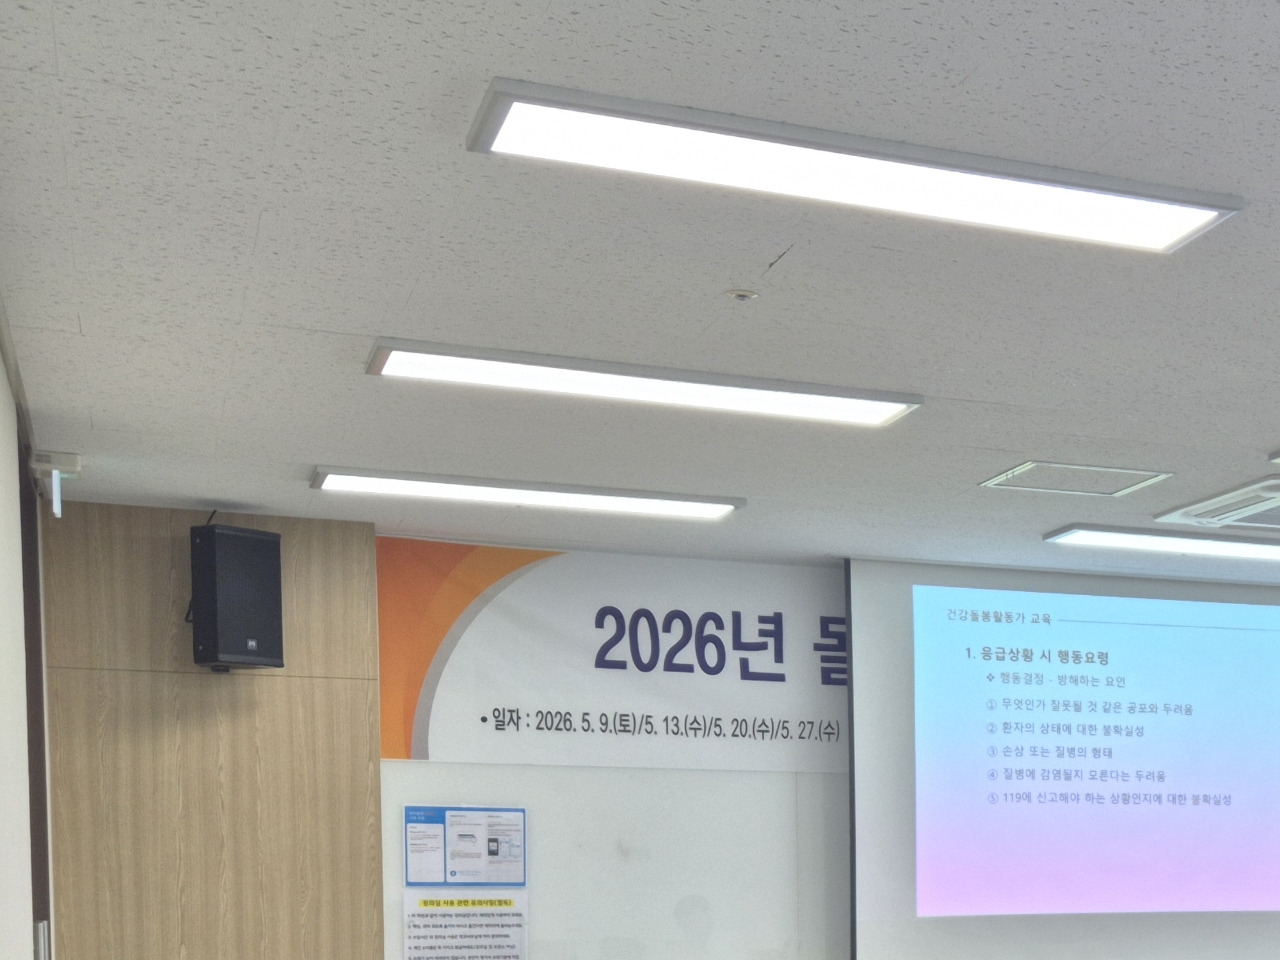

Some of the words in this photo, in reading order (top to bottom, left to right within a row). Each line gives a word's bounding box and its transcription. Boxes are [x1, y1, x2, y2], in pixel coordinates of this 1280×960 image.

[948, 609, 1025, 624] 건강돌봄활동가
[1031, 614, 1051, 625] 교육
[594, 604, 786, 682] 2026년
[966, 648, 975, 658] 1.
[981, 647, 1034, 662] 응급상황
[1040, 650, 1051, 663] 시
[1058, 650, 1108, 665] 행동요령
[1000, 672, 1043, 685] 행동결정
[1058, 675, 1100, 687] 방해하는
[1106, 677, 1125, 688] 요인
[1002, 698, 1046, 711] 무엇인가
[1051, 700, 1082, 712] 잘못될
[1088, 701, 1097, 712] 것
[1102, 702, 1122, 713] 같은
[1127, 702, 1158, 714] 공포와
[1163, 703, 1193, 716] 두려움
[493, 708, 521, 731] 일자
[526, 713, 530, 727] :
[536, 710, 576, 732] 2026.
[582, 712, 594, 732] 5.
[600, 712, 657, 735] 9.(토)/5.
[663, 715, 726, 738] 13.(수)/5.
[731, 718, 793, 740] 20.(수)/5.
[798, 720, 840, 742] 27.(수)
[1002, 722, 1034, 734] 환자의
[1040, 723, 1071, 735] 상태에
[1077, 724, 1097, 736] 대한
[1103, 725, 1144, 737] 불확실성
[1003, 746, 1024, 757] 손상
[1030, 746, 1050, 757] 또는
[1056, 746, 1086, 758] 질병의
[1092, 747, 1112, 759] 형태
[1004, 768, 1035, 780] 질병에
[1041, 769, 1082, 781] 감염될지
[1089, 770, 1130, 782] 모른다는
[1136, 771, 1166, 782] 두려움
[1004, 792, 1031, 803] 119에
[1037, 792, 1080, 804] 신고해야
[1085, 793, 1105, 804] 하는
[1111, 793, 1162, 805] 상황인지에
[1167, 794, 1187, 805] 대한
[1192, 794, 1231, 806] 불확실성
